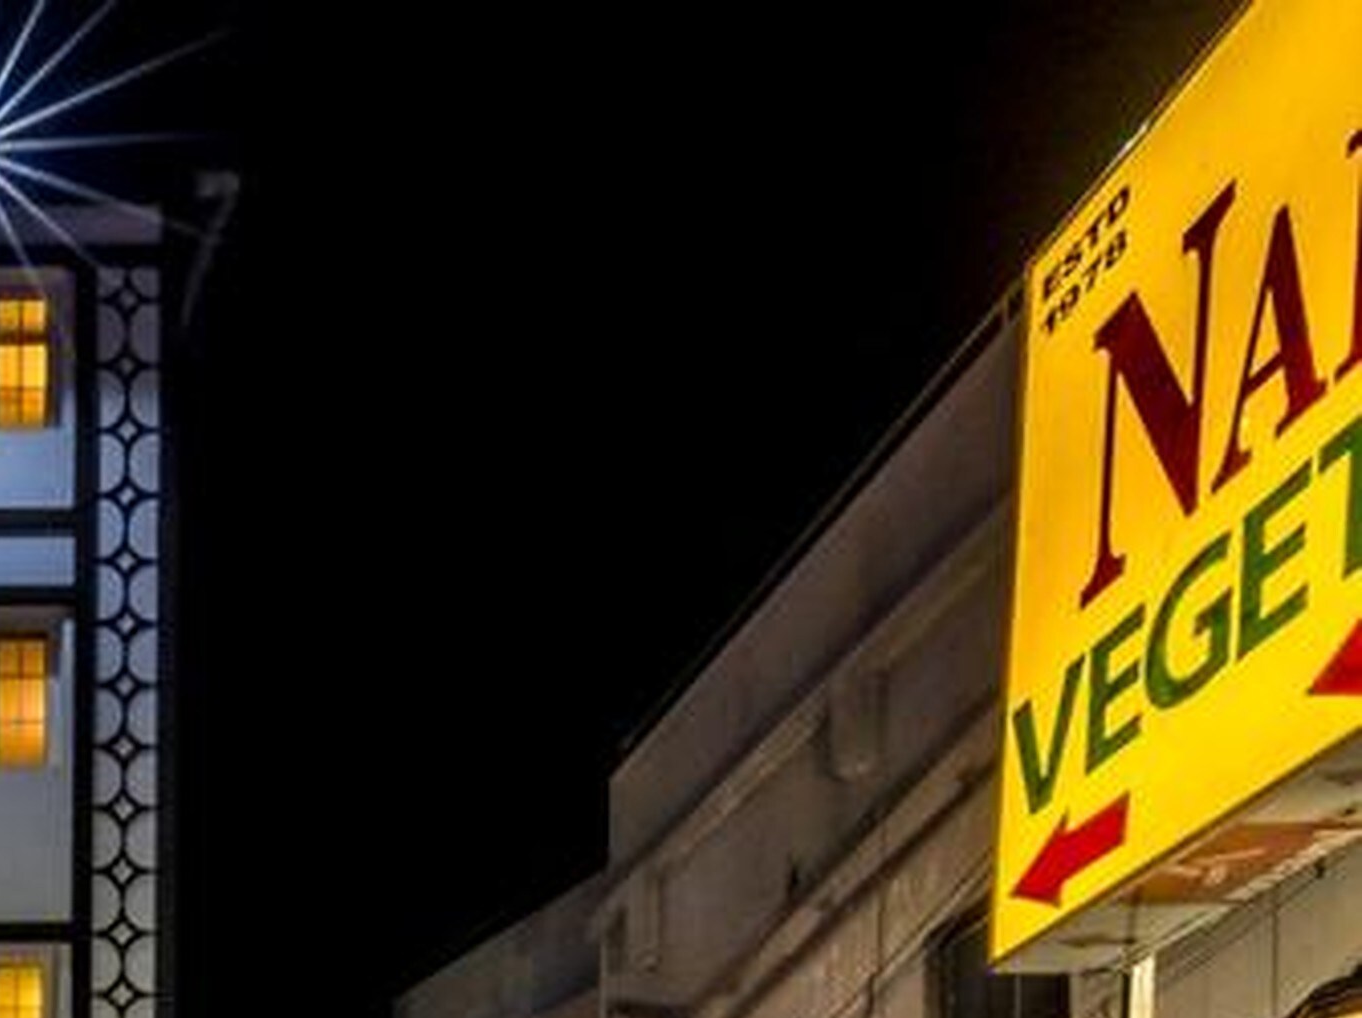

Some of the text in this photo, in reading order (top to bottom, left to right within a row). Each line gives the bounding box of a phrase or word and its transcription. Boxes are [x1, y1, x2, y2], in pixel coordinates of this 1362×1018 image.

[1042, 184, 1131, 301] ESTD
[1043, 229, 1128, 336] 1978
[1080, 128, 1362, 610] NA
